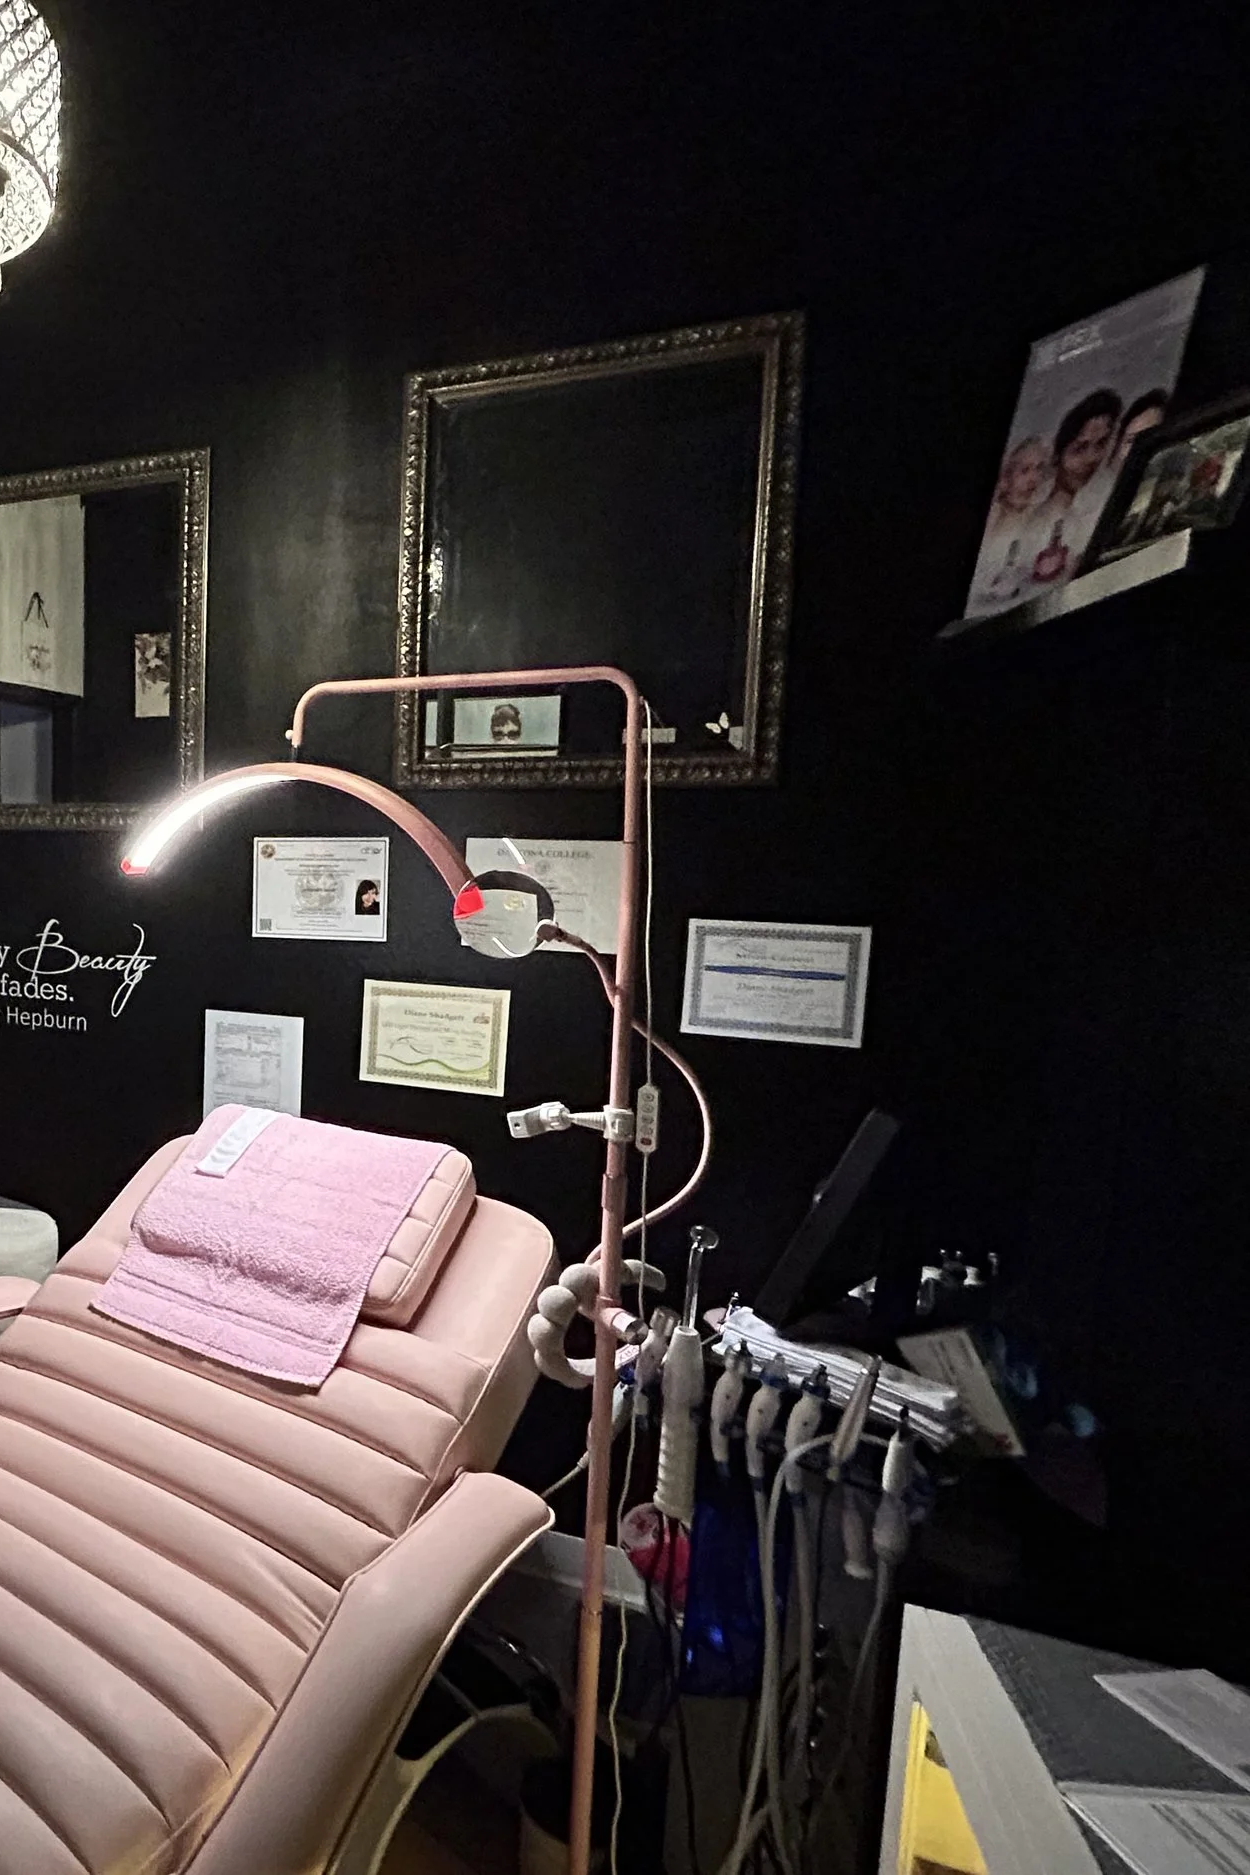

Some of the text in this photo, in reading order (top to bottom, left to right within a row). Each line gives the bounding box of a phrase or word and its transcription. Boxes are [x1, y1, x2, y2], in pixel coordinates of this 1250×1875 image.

[16, 919, 157, 1017] Beauty
[0, 973, 74, 1002] fades.
[7, 1006, 87, 1031] Hepburn
